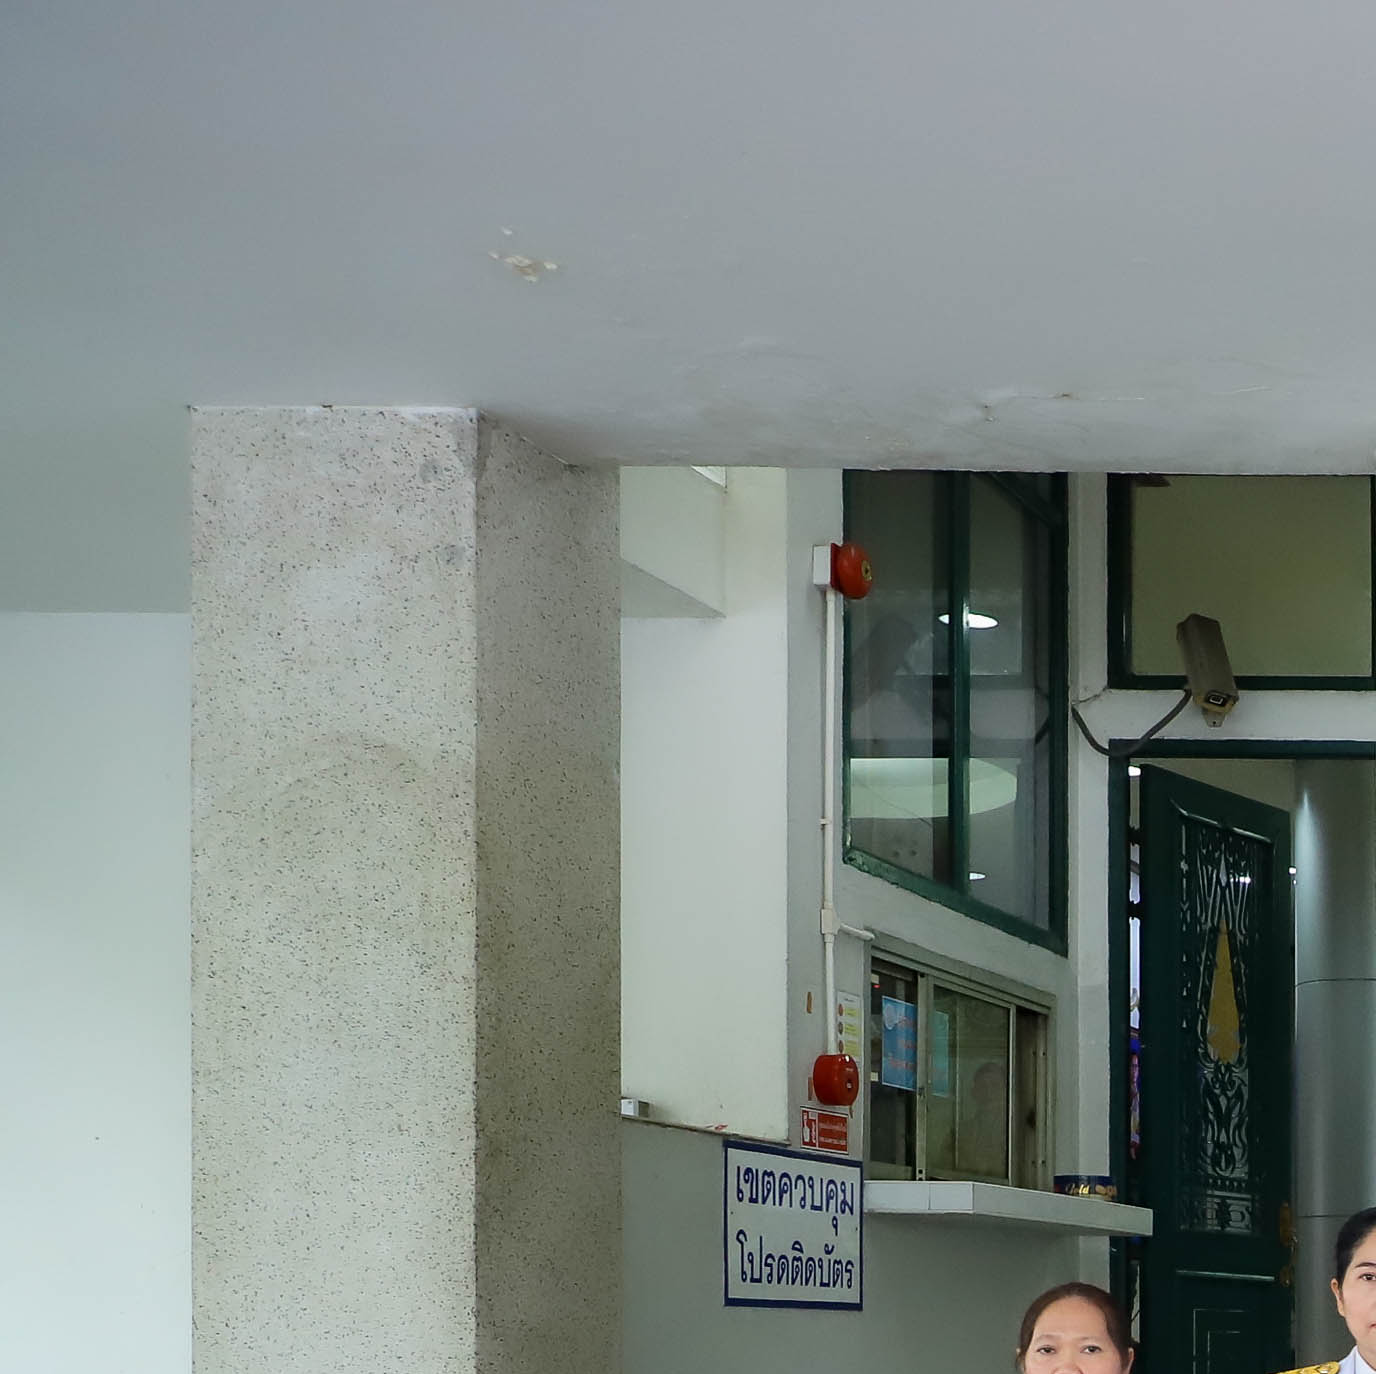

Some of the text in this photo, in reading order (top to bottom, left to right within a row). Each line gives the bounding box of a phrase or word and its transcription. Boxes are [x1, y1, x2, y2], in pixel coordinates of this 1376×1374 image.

[736, 1165, 855, 1237] เขตควบคุม
[735, 1229, 855, 1289] โปรดติดบัตร
